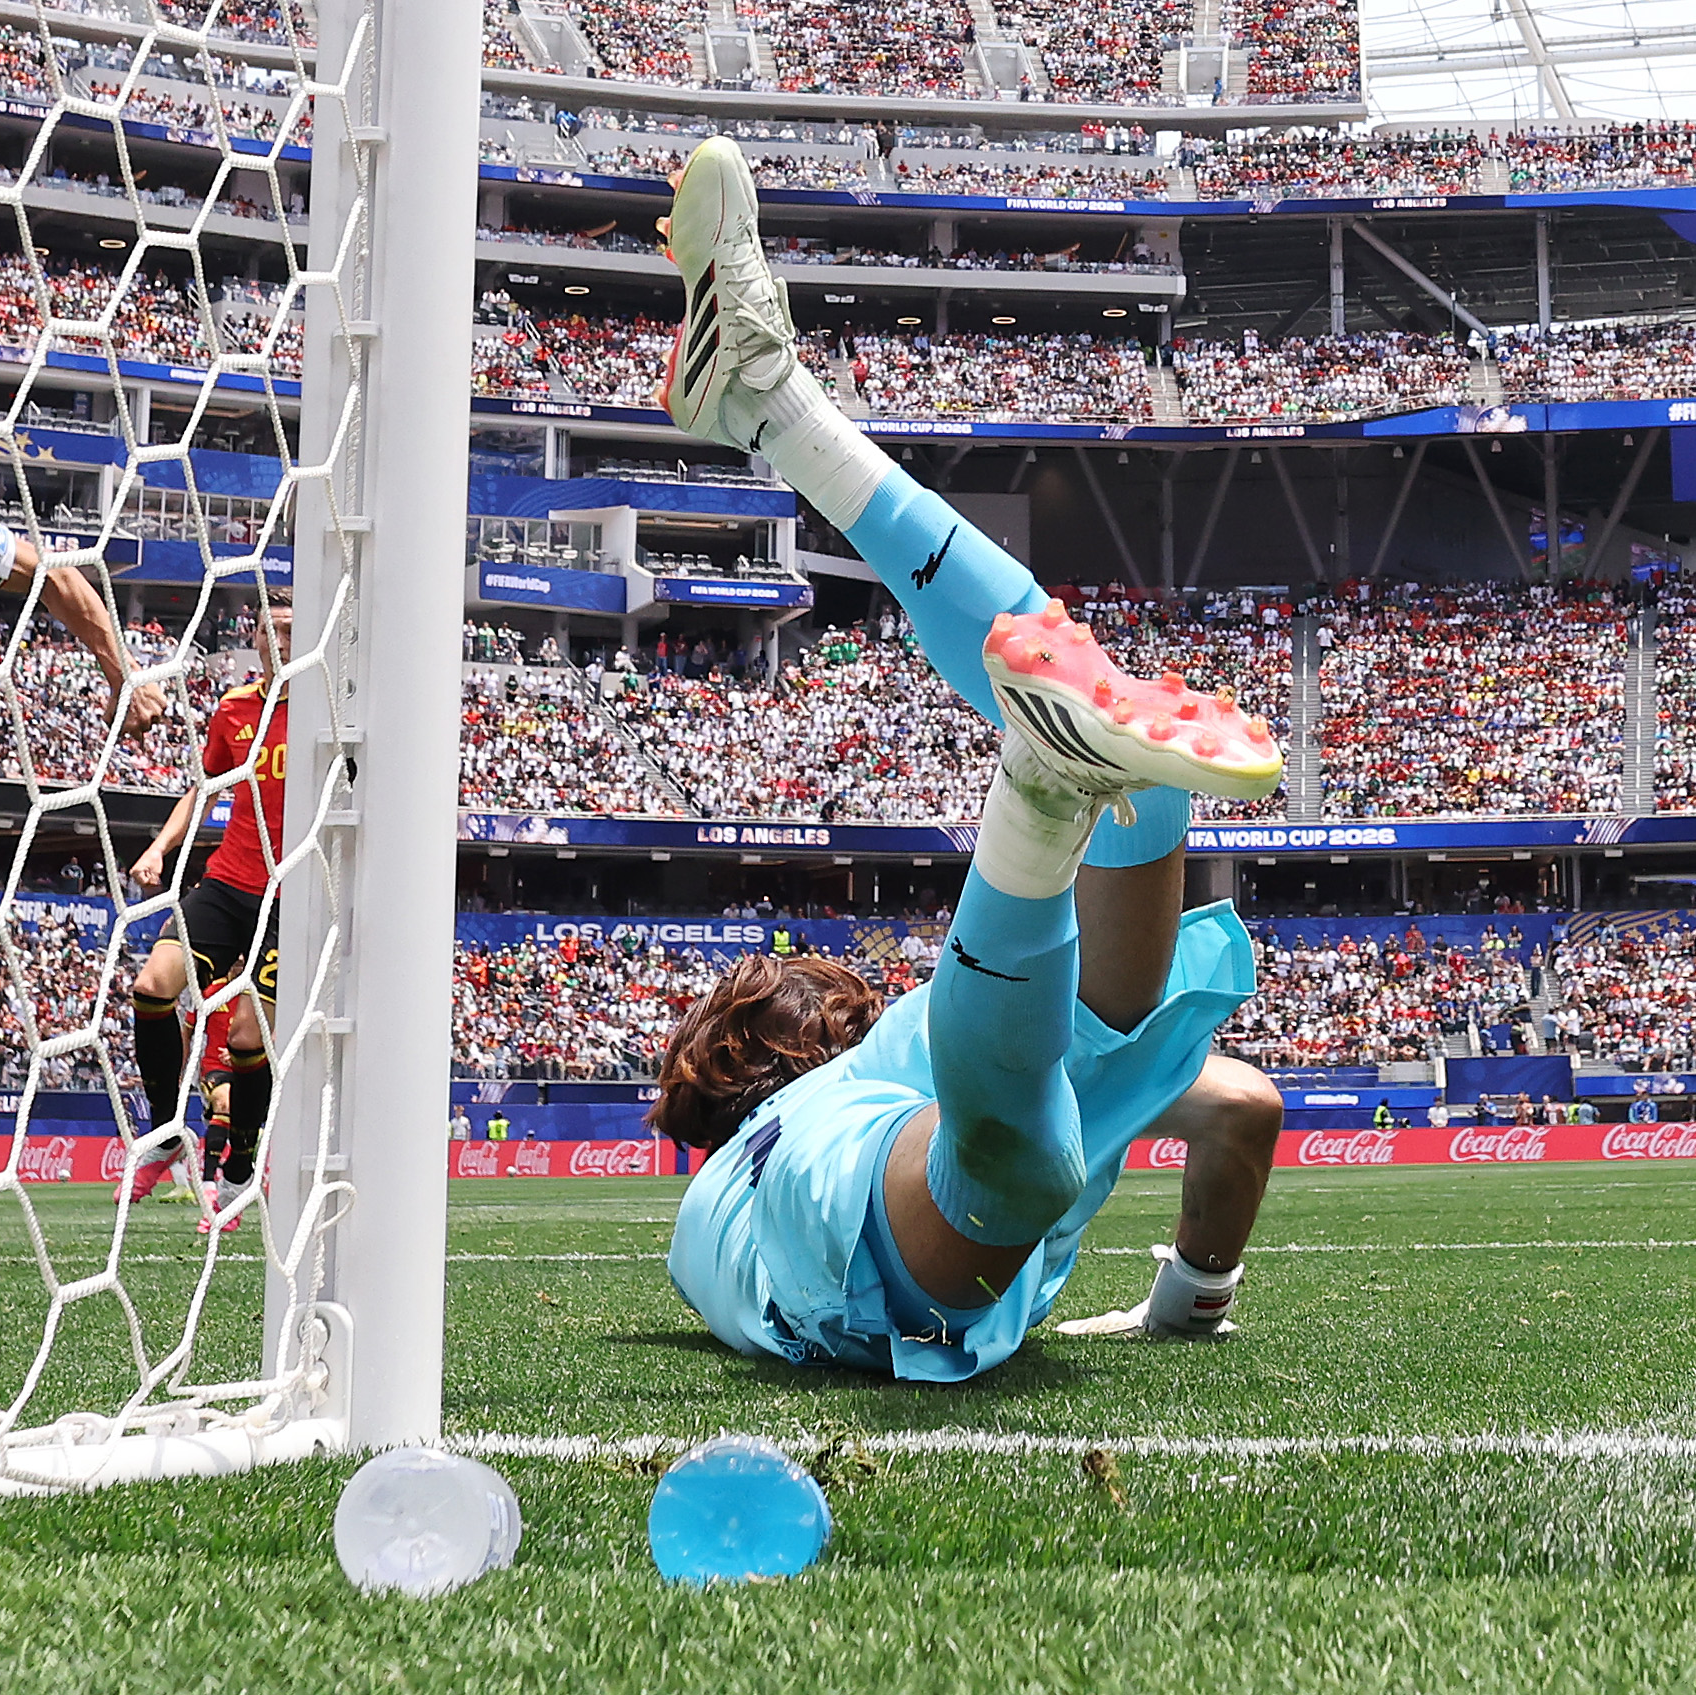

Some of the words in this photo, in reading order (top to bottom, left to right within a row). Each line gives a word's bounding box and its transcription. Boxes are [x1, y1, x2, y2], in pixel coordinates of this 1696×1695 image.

[8, 103, 52, 119] ANGEL
[1006, 198, 1029, 210] FIFA
[1029, 199, 1069, 210] WORLD
[1069, 199, 1089, 211] CUP
[1089, 200, 1125, 212] 2026
[1372, 198, 1395, 209] LOS
[1396, 197, 1447, 209] ANGELES
[512, 401, 537, 413] LOS
[538, 403, 592, 417] ANGELES
[871, 422, 910, 434] WORLD
[910, 423, 932, 434] CUP
[932, 423, 973, 435] 2026
[1226, 426, 1250, 438] LOS
[1251, 426, 1304, 437] ANGELES
[707, 586, 736, 596] WORLD
[736, 587, 751, 597] CUP
[255, 743, 287, 782] 20
[697, 824, 737, 844] LOS
[740, 827, 831, 846] ANGELES
[1187, 831, 1218, 848] IFA
[1219, 830, 1287, 848] WORLD
[1288, 829, 1327, 847] CUP
[1329, 827, 1398, 846] 2026
[536, 922, 602, 943] LOS
[1298, 1130, 1400, 1165] Coca-Cola
[1449, 1126, 1552, 1162] Coca-Cola
[569, 1140, 655, 1176] Coca-Cola
